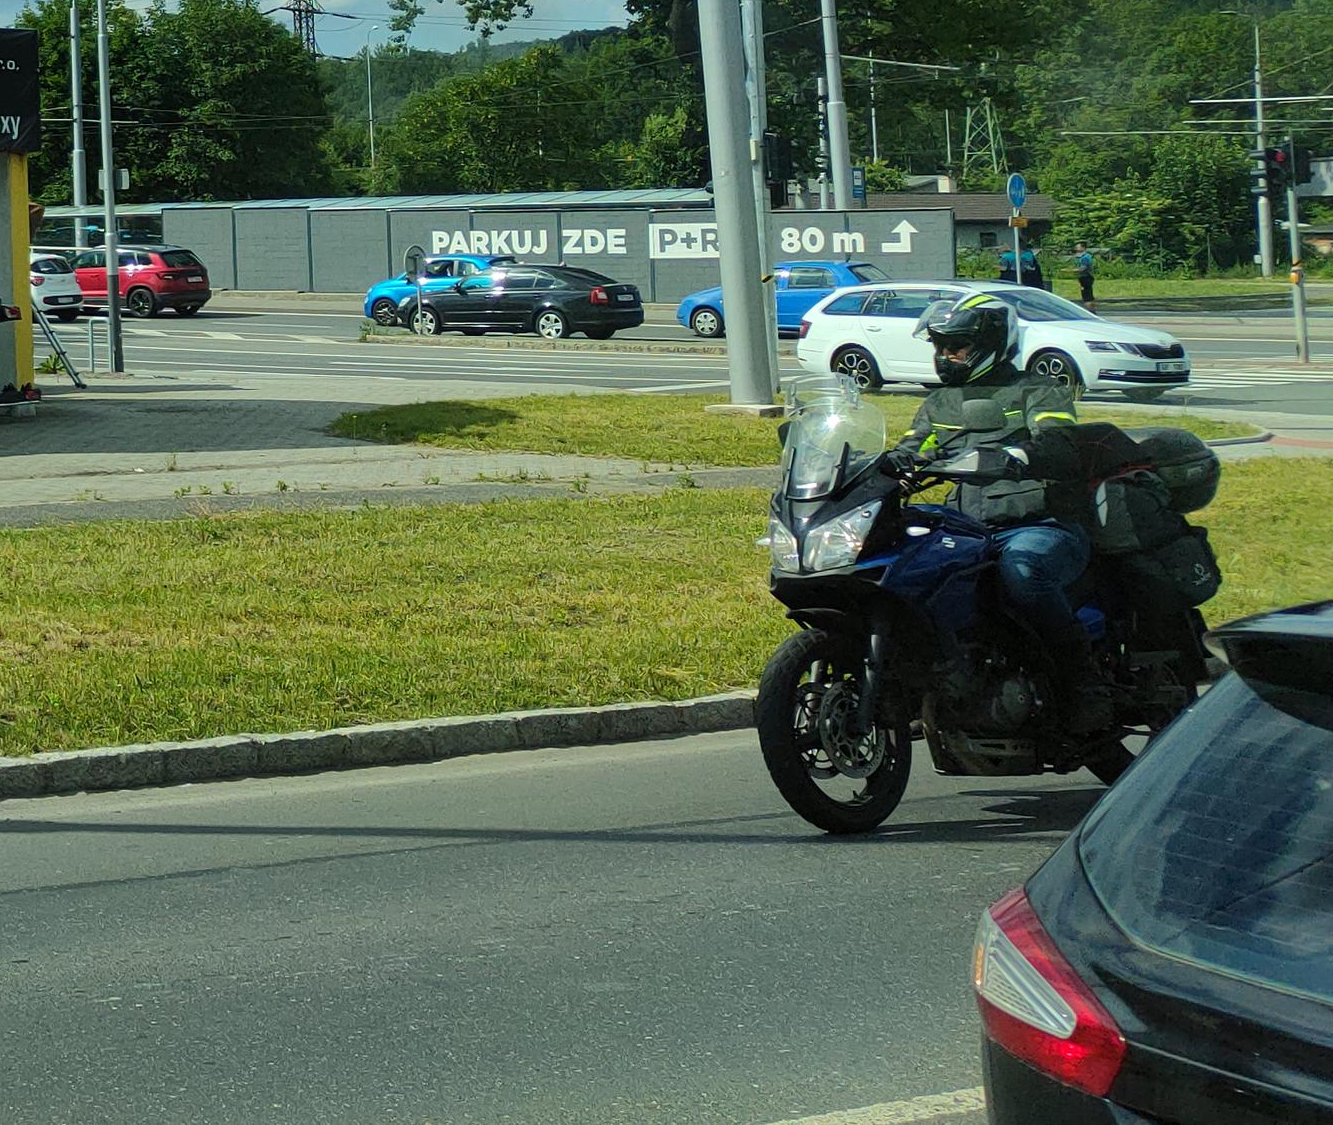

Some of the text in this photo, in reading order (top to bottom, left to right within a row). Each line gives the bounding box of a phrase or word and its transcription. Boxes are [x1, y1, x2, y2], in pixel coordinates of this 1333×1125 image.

[432, 226, 865, 254] PARKUJ ZDE P+R 80 m
